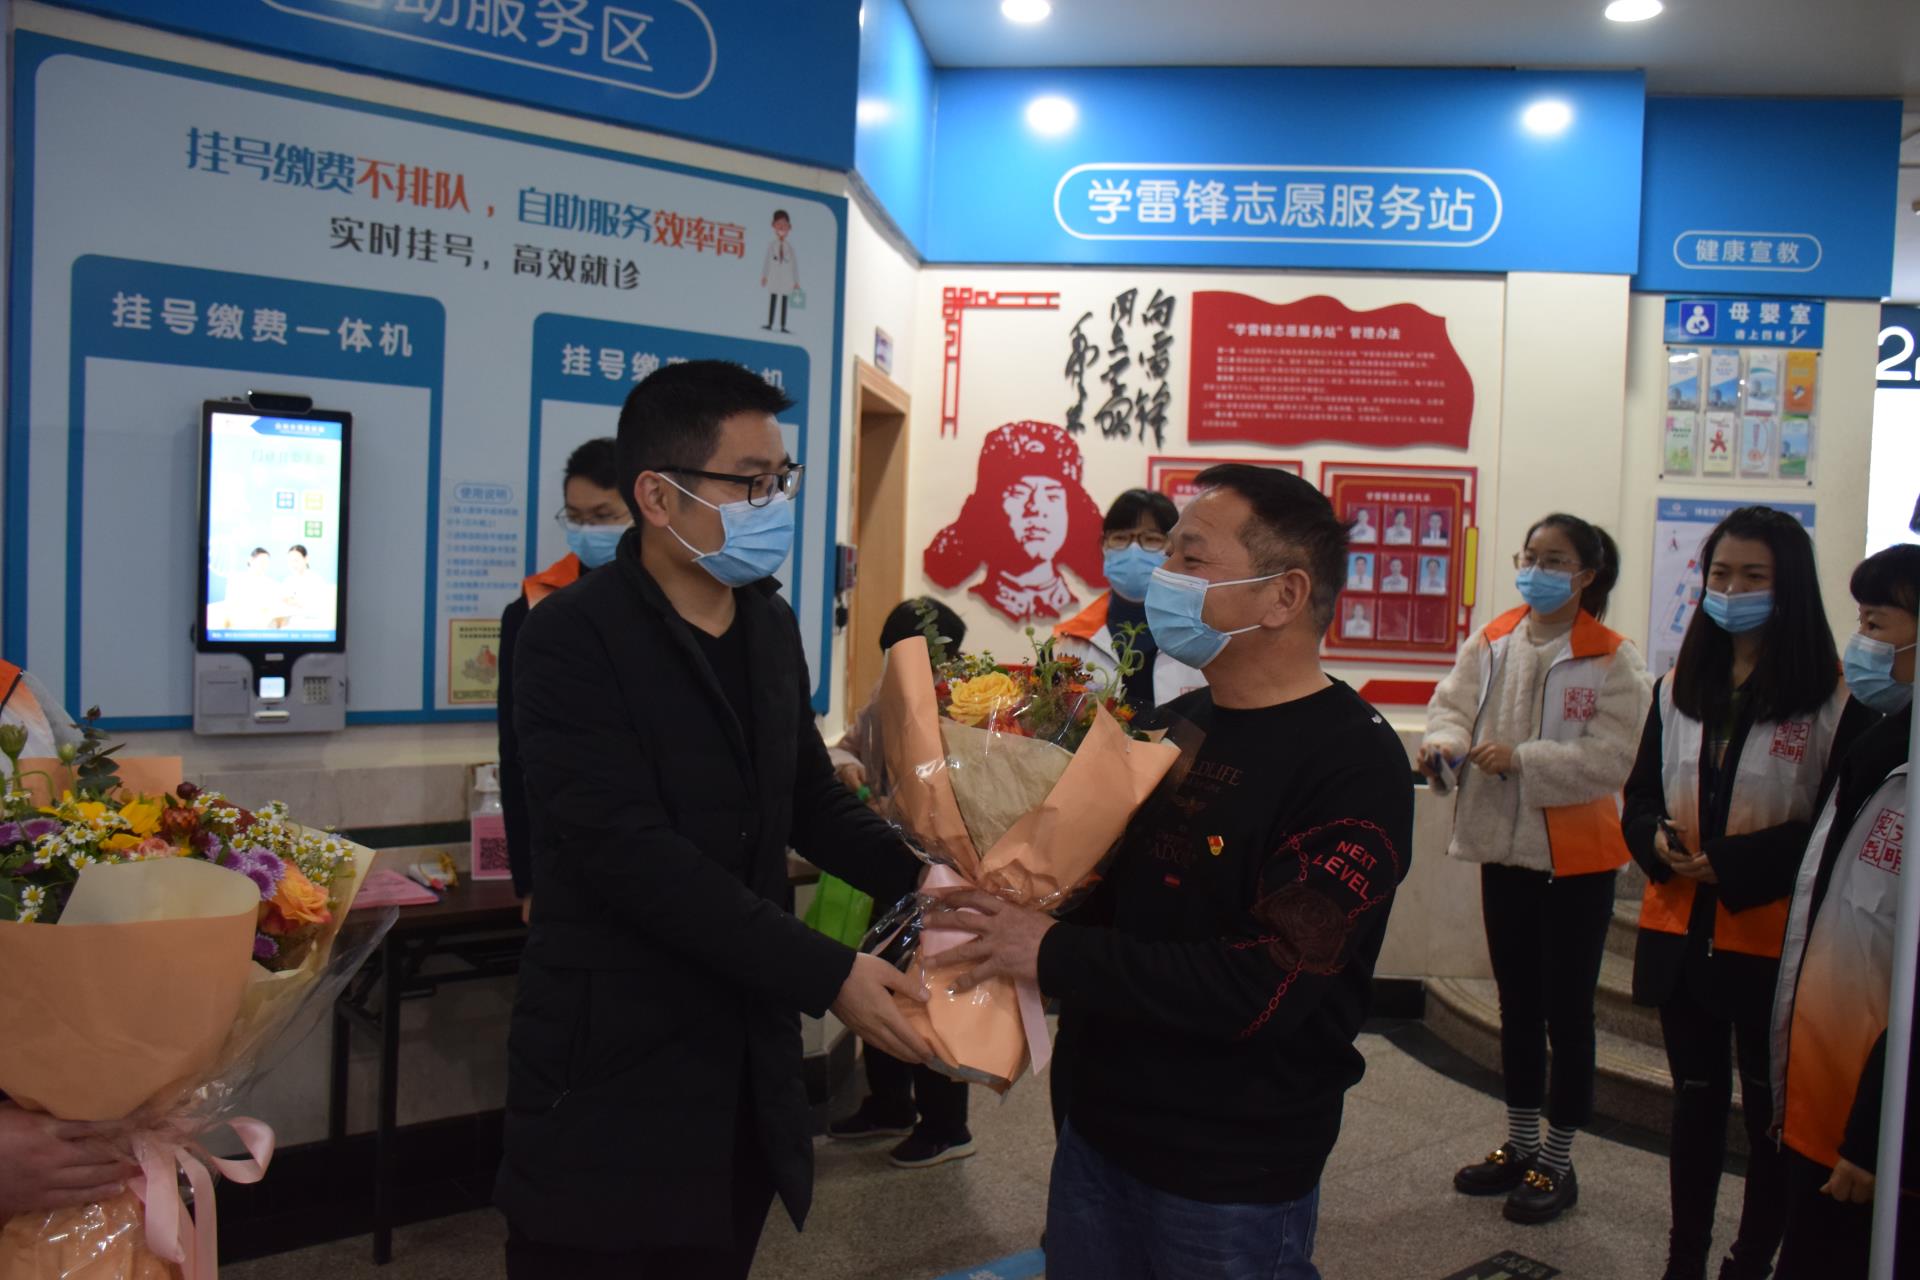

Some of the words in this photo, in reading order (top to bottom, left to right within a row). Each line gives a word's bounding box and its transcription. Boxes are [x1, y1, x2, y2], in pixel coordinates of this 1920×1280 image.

[338, 0, 653, 71] 服务区
[1087, 179, 1476, 232] 学雷锋志愿服务站
[1695, 238, 1800, 264] 健康宣教
[112, 291, 413, 357] 挂号缴费一体机
[1728, 301, 1812, 325] 母婴室
[1312, 854, 1370, 900] LEVEL
[1335, 840, 1377, 871] NEXT
